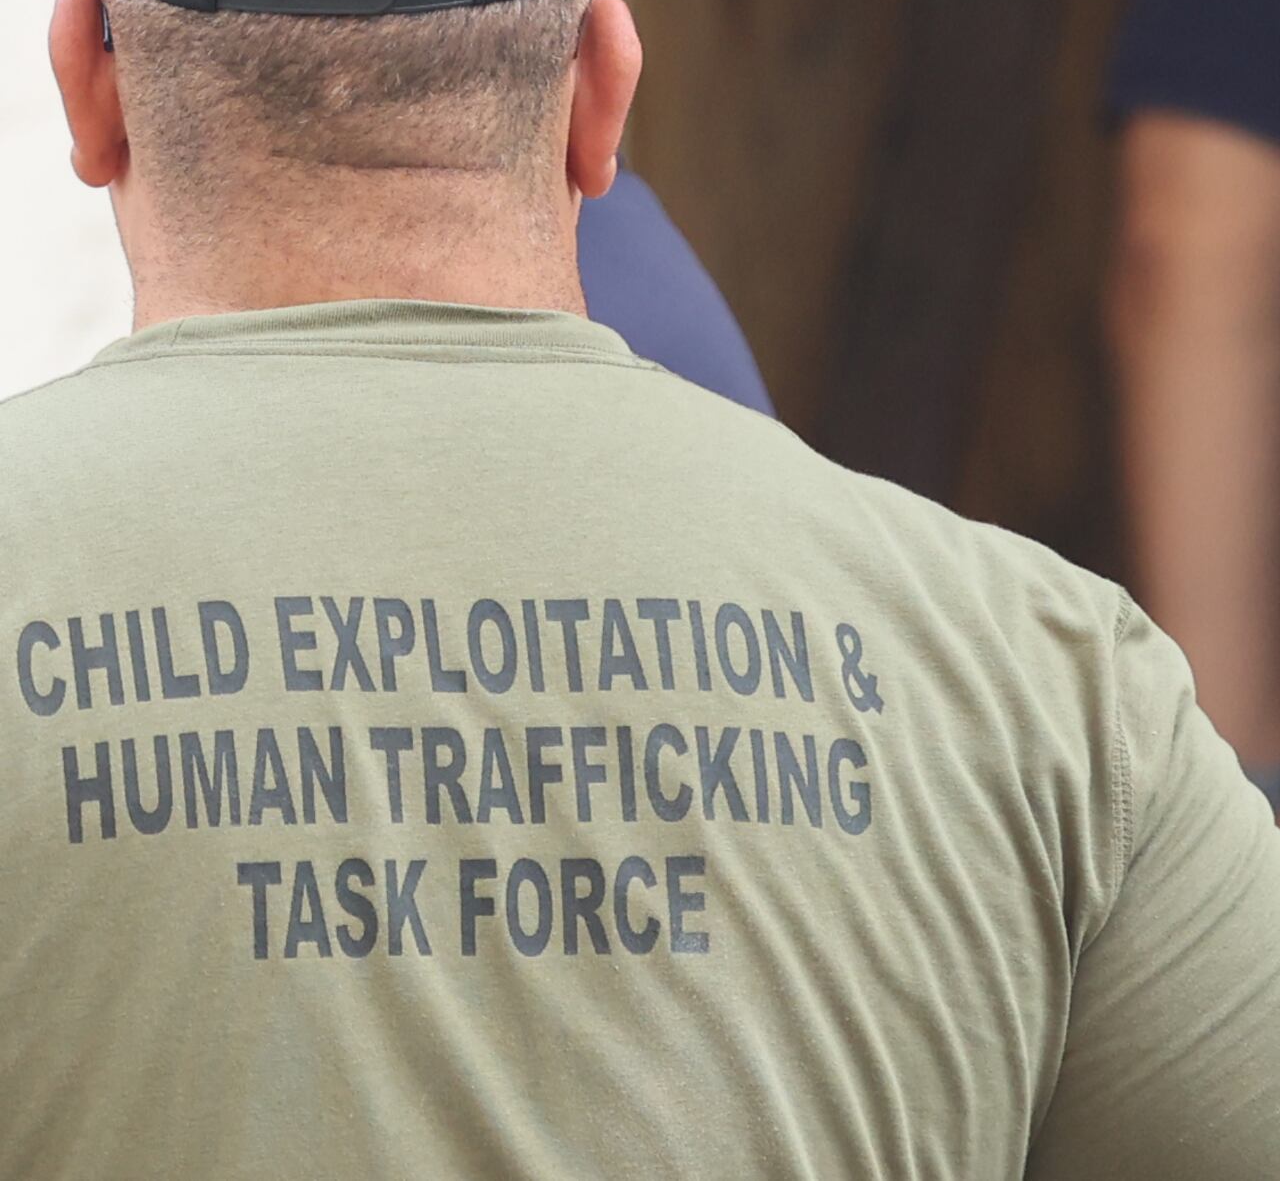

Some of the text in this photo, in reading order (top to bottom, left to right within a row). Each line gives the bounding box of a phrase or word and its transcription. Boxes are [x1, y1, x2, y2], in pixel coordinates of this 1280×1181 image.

[16, 595, 885, 717] CHILD EXPLOITATION &
[61, 722, 873, 844] HUMAN TRAFFICKING
[235, 853, 711, 960] TASK FORCE
